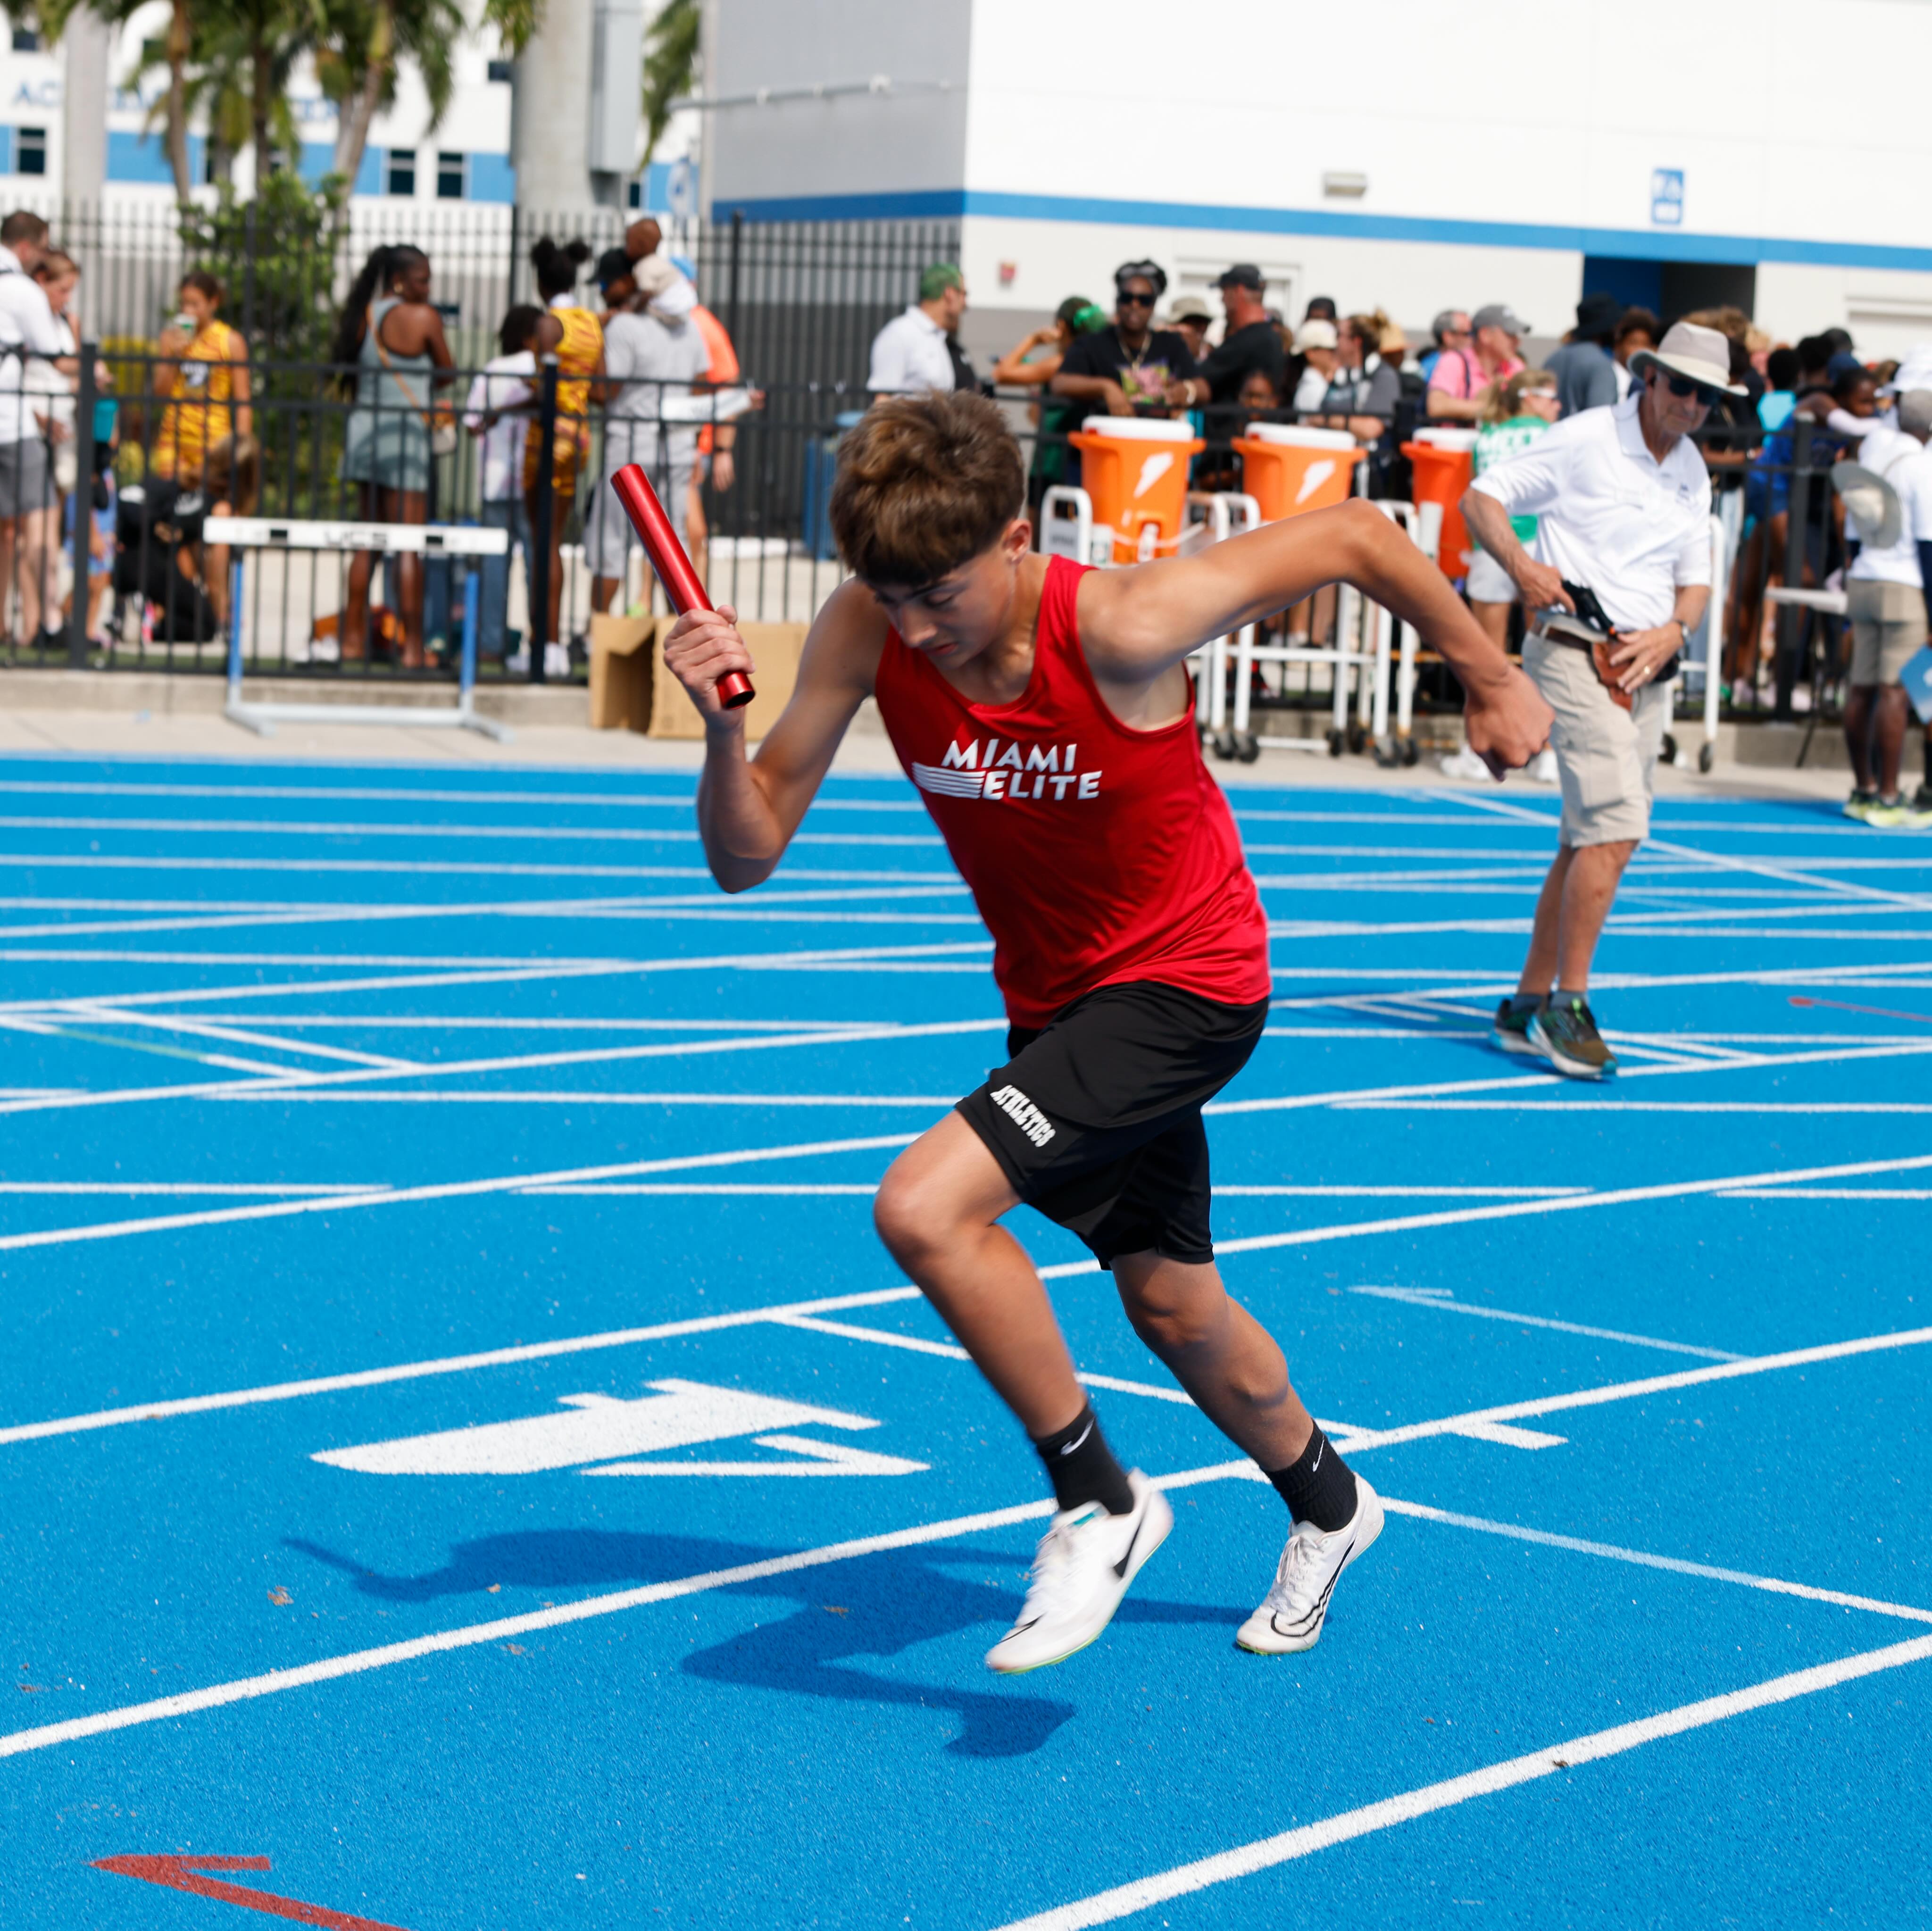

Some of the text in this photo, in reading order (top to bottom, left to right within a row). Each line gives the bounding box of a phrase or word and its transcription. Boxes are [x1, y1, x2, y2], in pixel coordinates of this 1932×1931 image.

[942, 739, 1077, 772] MIAMI
[983, 770, 1103, 800] ELITE
[990, 1084, 1056, 1148] ATHLETICS
